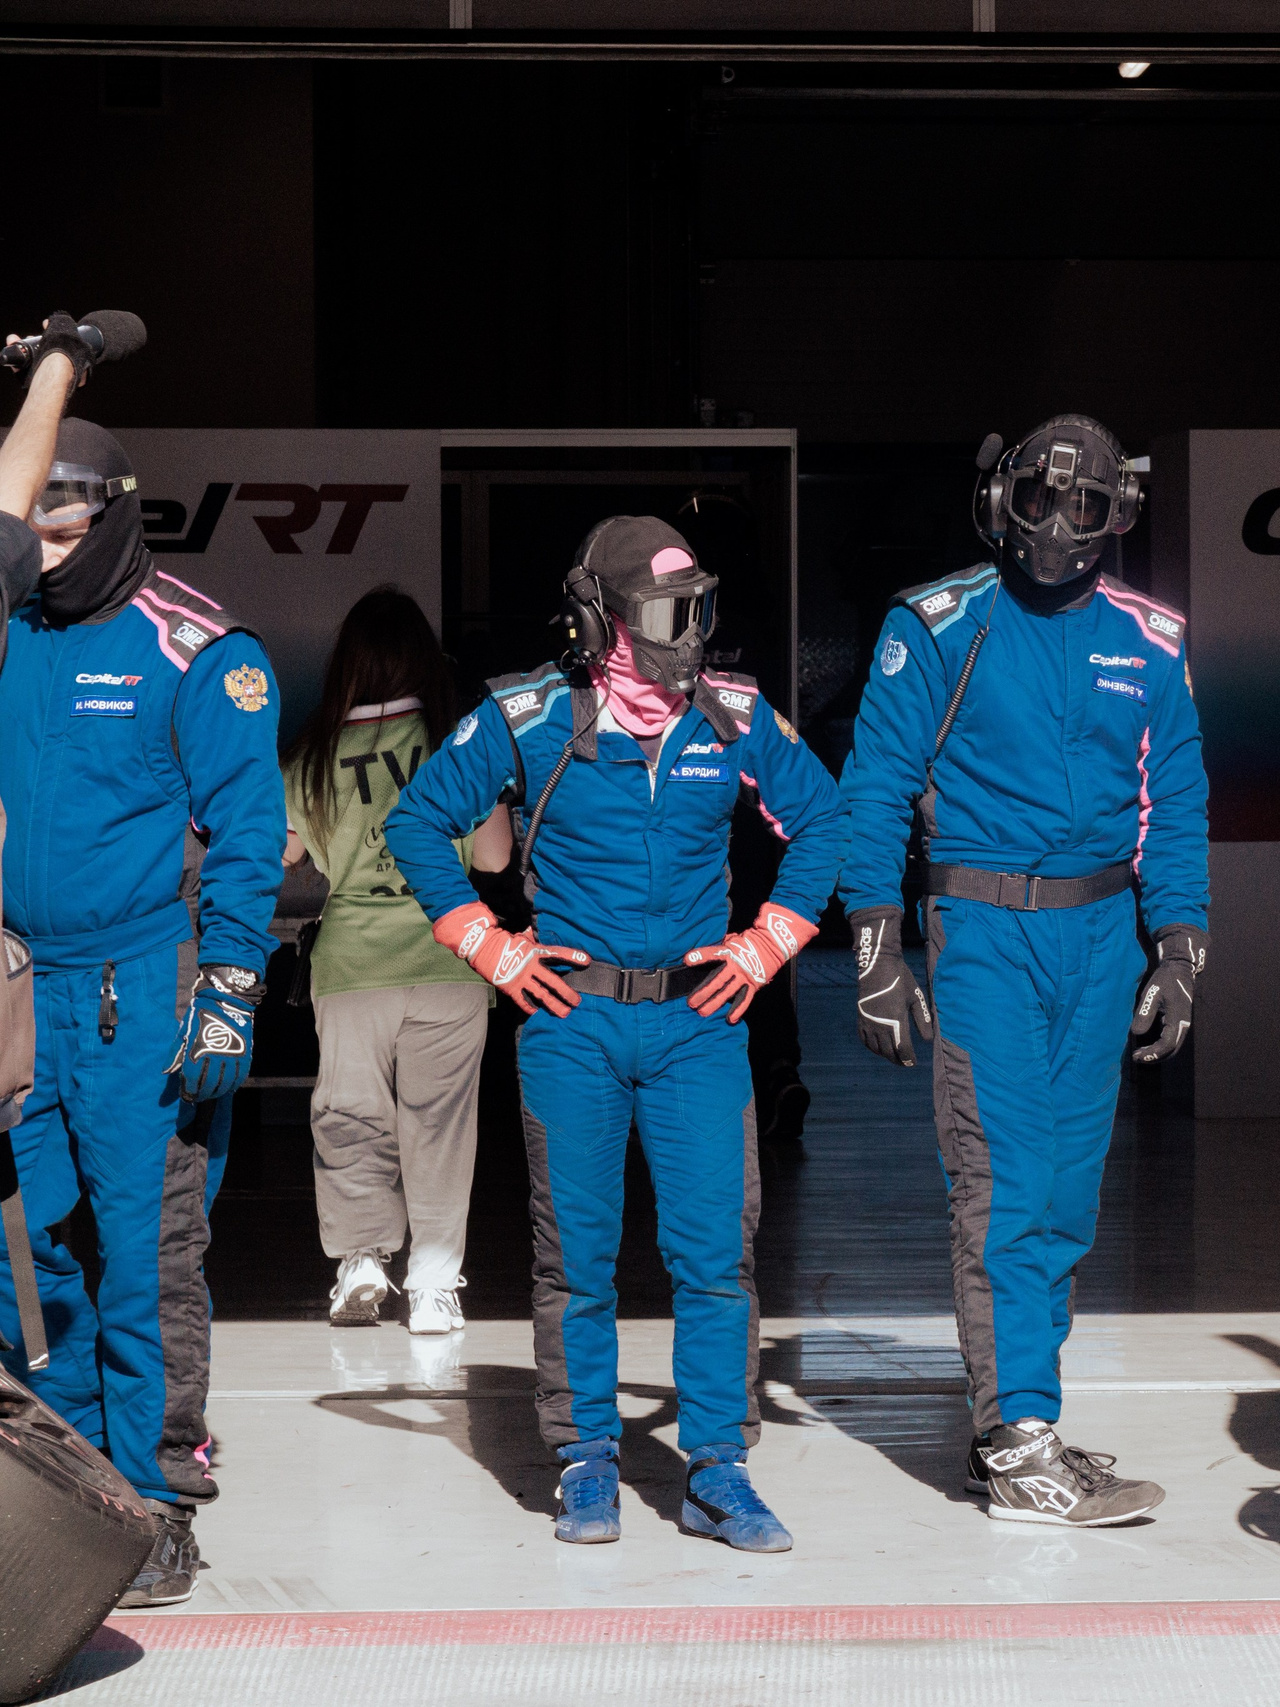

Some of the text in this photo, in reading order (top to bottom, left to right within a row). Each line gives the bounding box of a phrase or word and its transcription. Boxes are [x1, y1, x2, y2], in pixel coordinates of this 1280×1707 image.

[923, 593, 952, 612] OMP
[1149, 614, 1179, 634] OMP
[176, 625, 205, 645] OMP
[84, 700, 134, 710] НОВИКОВ
[507, 693, 537, 714] OMP
[718, 692, 750, 709] OMP
[340, 746, 423, 804] TV
[681, 767, 720, 778] БУРДИН
[859, 927, 872, 968] sparco
[915, 987, 932, 1023] sparco
[1139, 984, 1160, 1016] sparco
